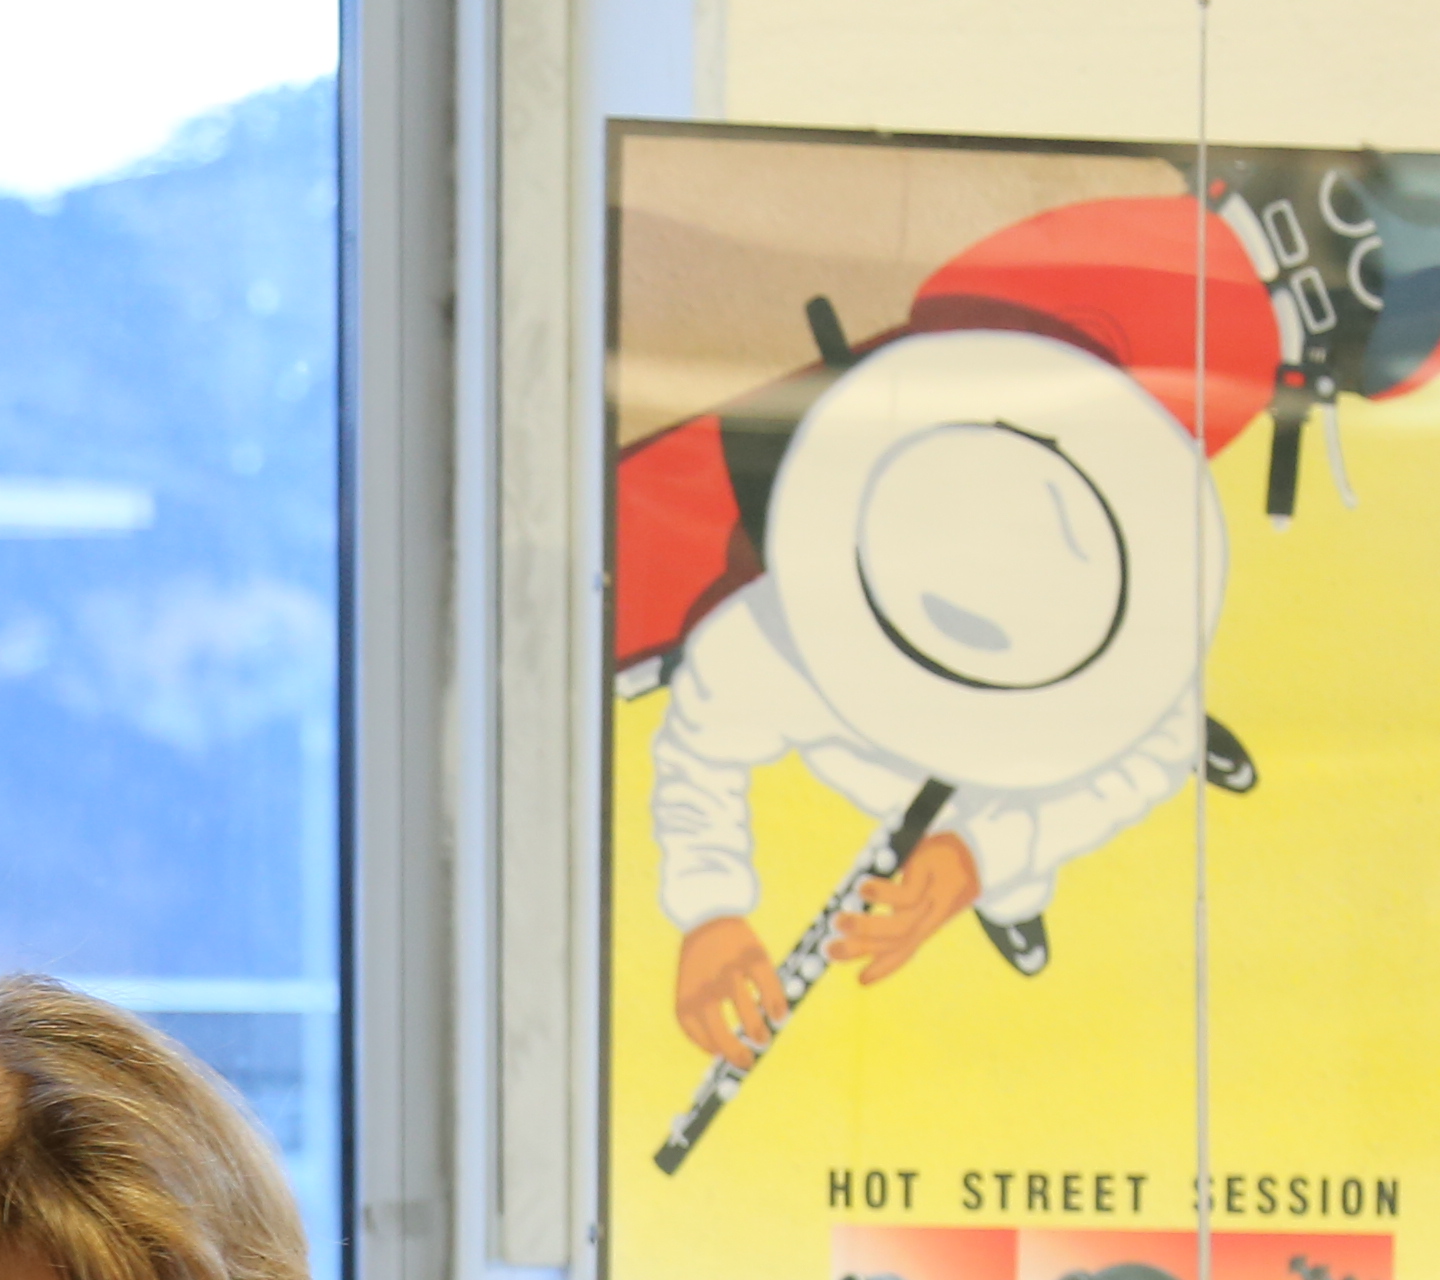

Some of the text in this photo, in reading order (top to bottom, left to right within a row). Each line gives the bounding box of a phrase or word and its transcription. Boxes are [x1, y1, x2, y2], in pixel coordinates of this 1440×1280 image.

[827, 1170, 1401, 1216] HOT STREET SESSION
